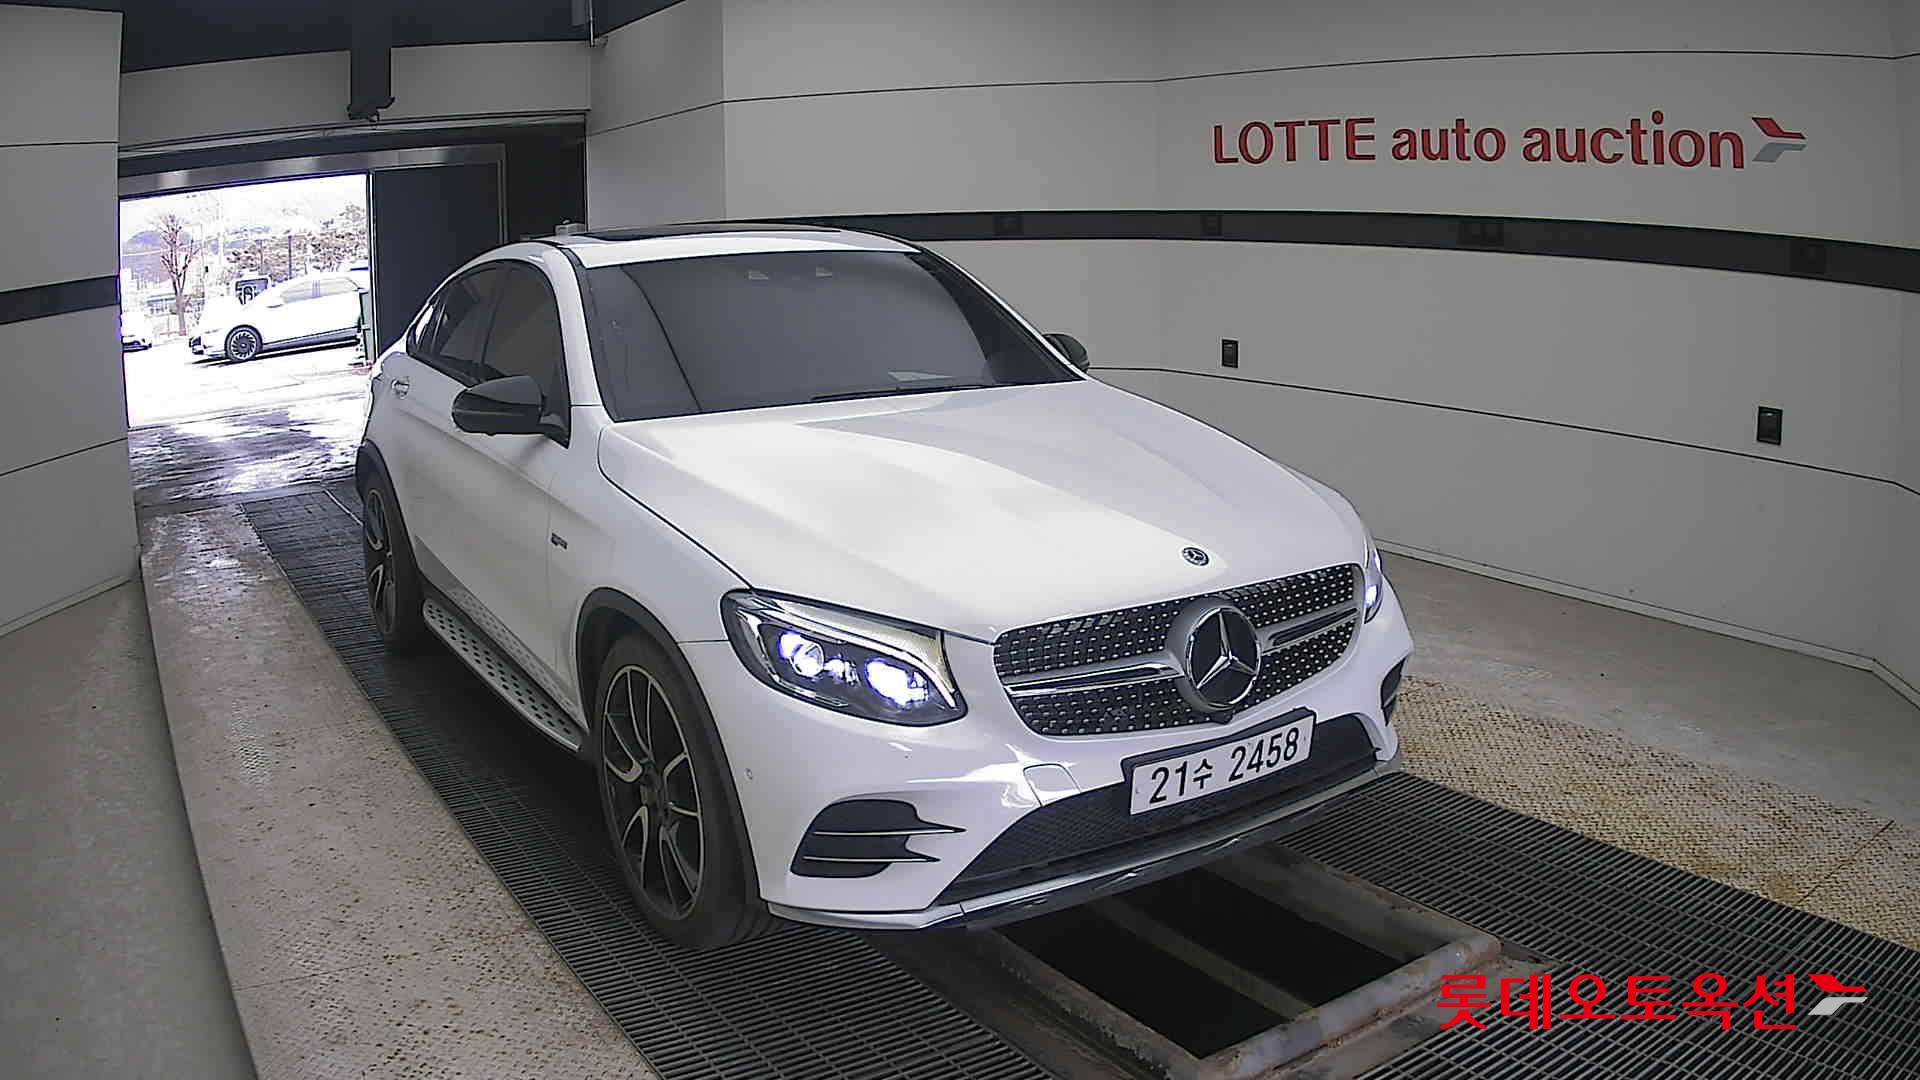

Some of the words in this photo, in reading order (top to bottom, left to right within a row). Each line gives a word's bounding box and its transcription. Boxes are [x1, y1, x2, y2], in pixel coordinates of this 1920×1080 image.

[1214, 117, 1376, 164] LOTTE
[1391, 118, 1506, 162] auto
[1522, 111, 1745, 169] auction
[1149, 758, 1213, 804] 21수
[1228, 727, 1300, 783] 2458
